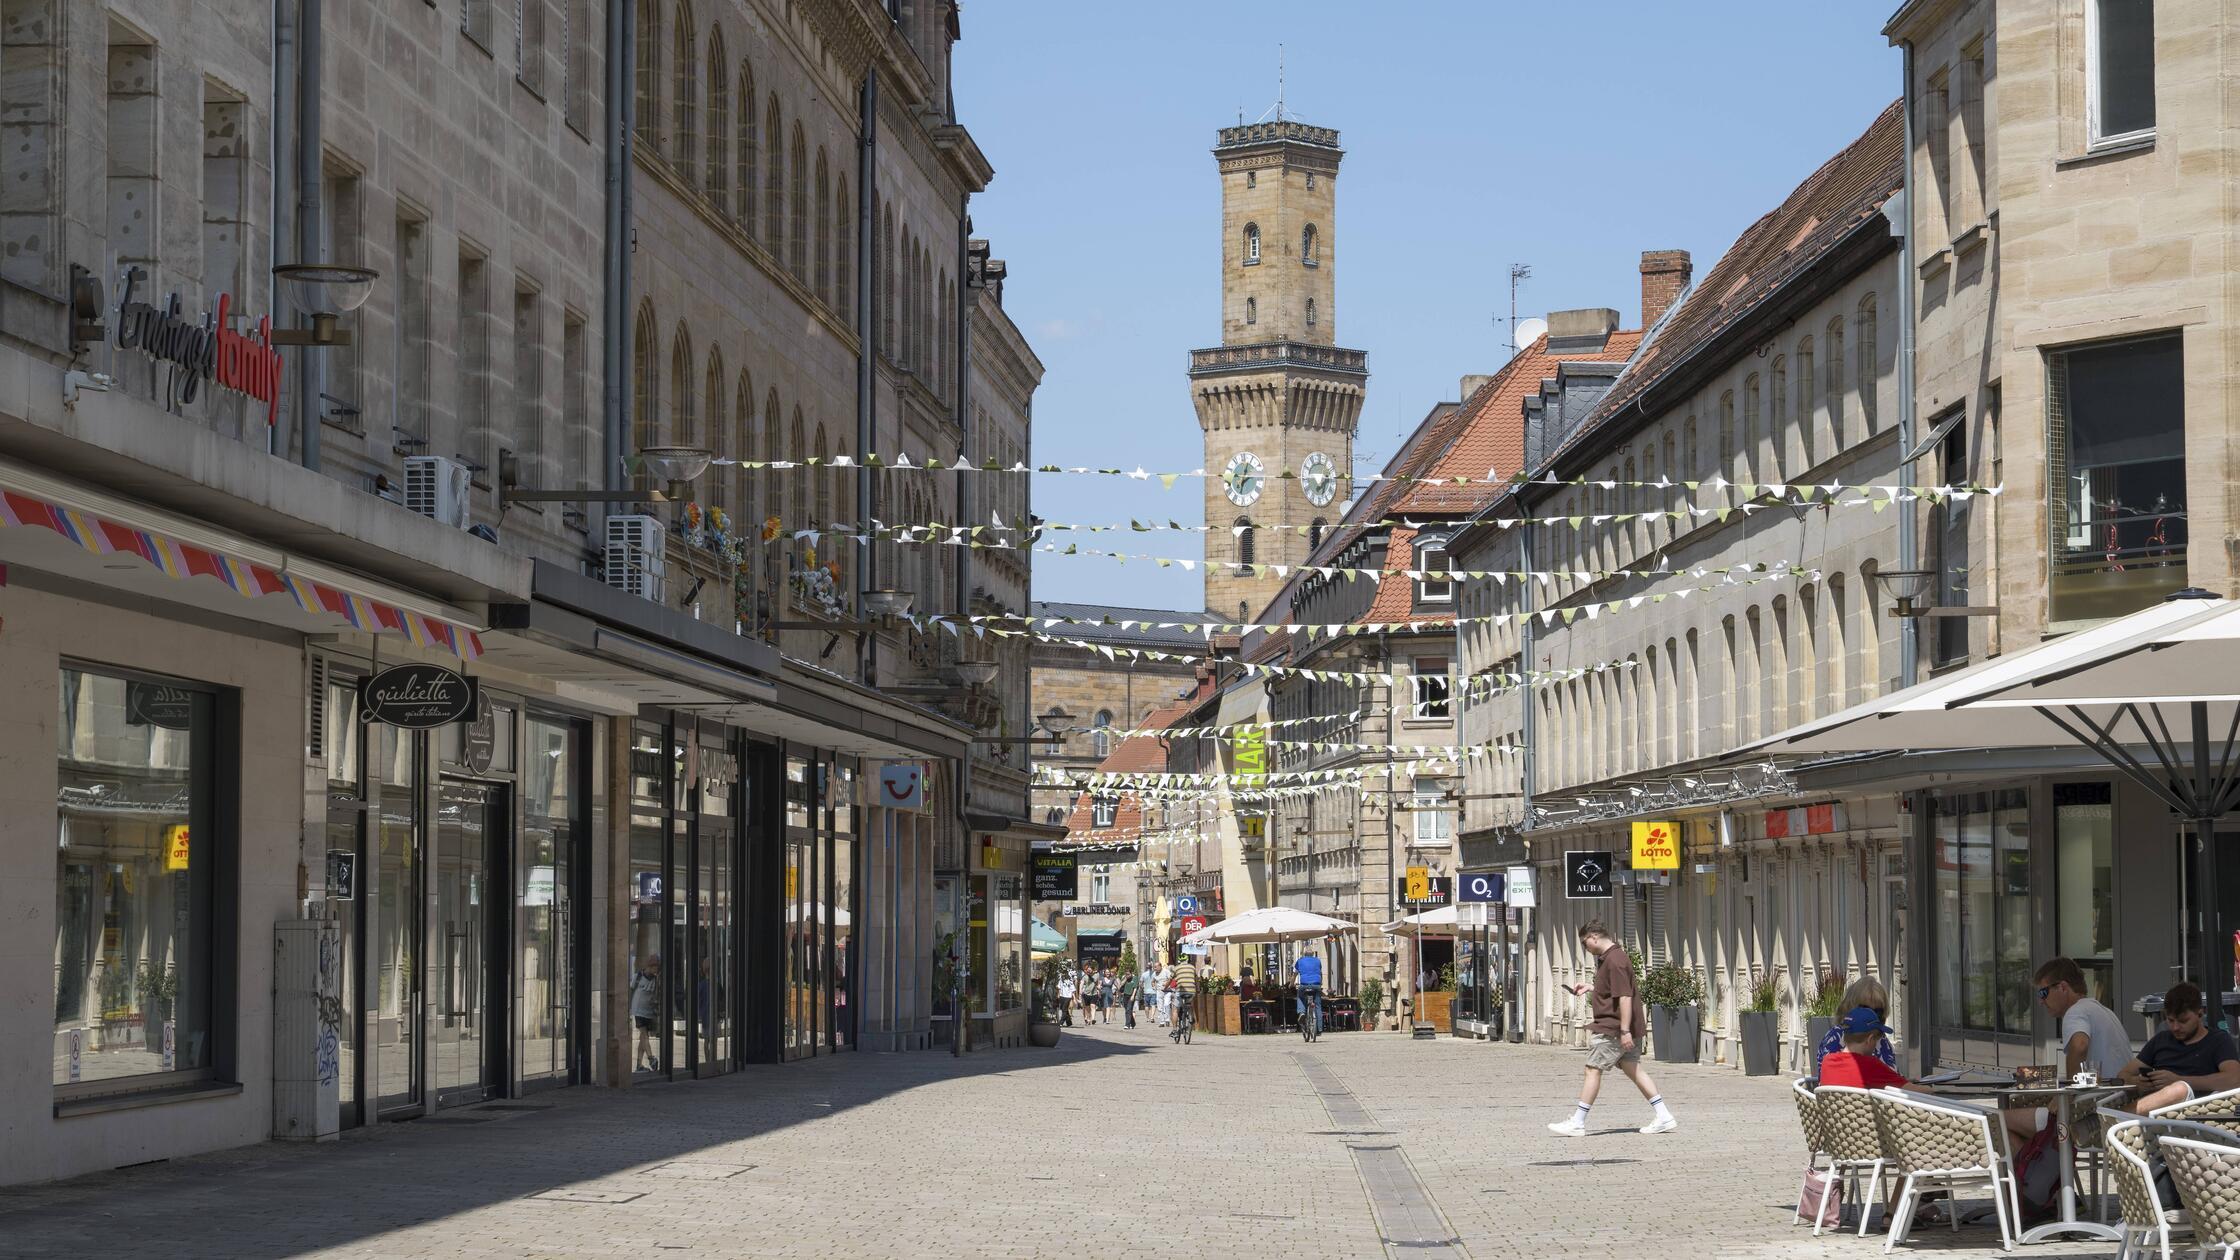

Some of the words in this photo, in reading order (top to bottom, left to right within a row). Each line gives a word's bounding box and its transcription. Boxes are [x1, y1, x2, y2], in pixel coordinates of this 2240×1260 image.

[216, 292, 283, 426] family
[360, 672, 455, 723] giulietta
[1641, 848, 1672, 857] LOTTO
[1036, 858, 1072, 867] VITALIA
[1042, 888, 1073, 897] gesund
[1577, 884, 1603, 892] AURA
[1072, 905, 1105, 915] BERLINER
[1185, 922, 1202, 931] DER
